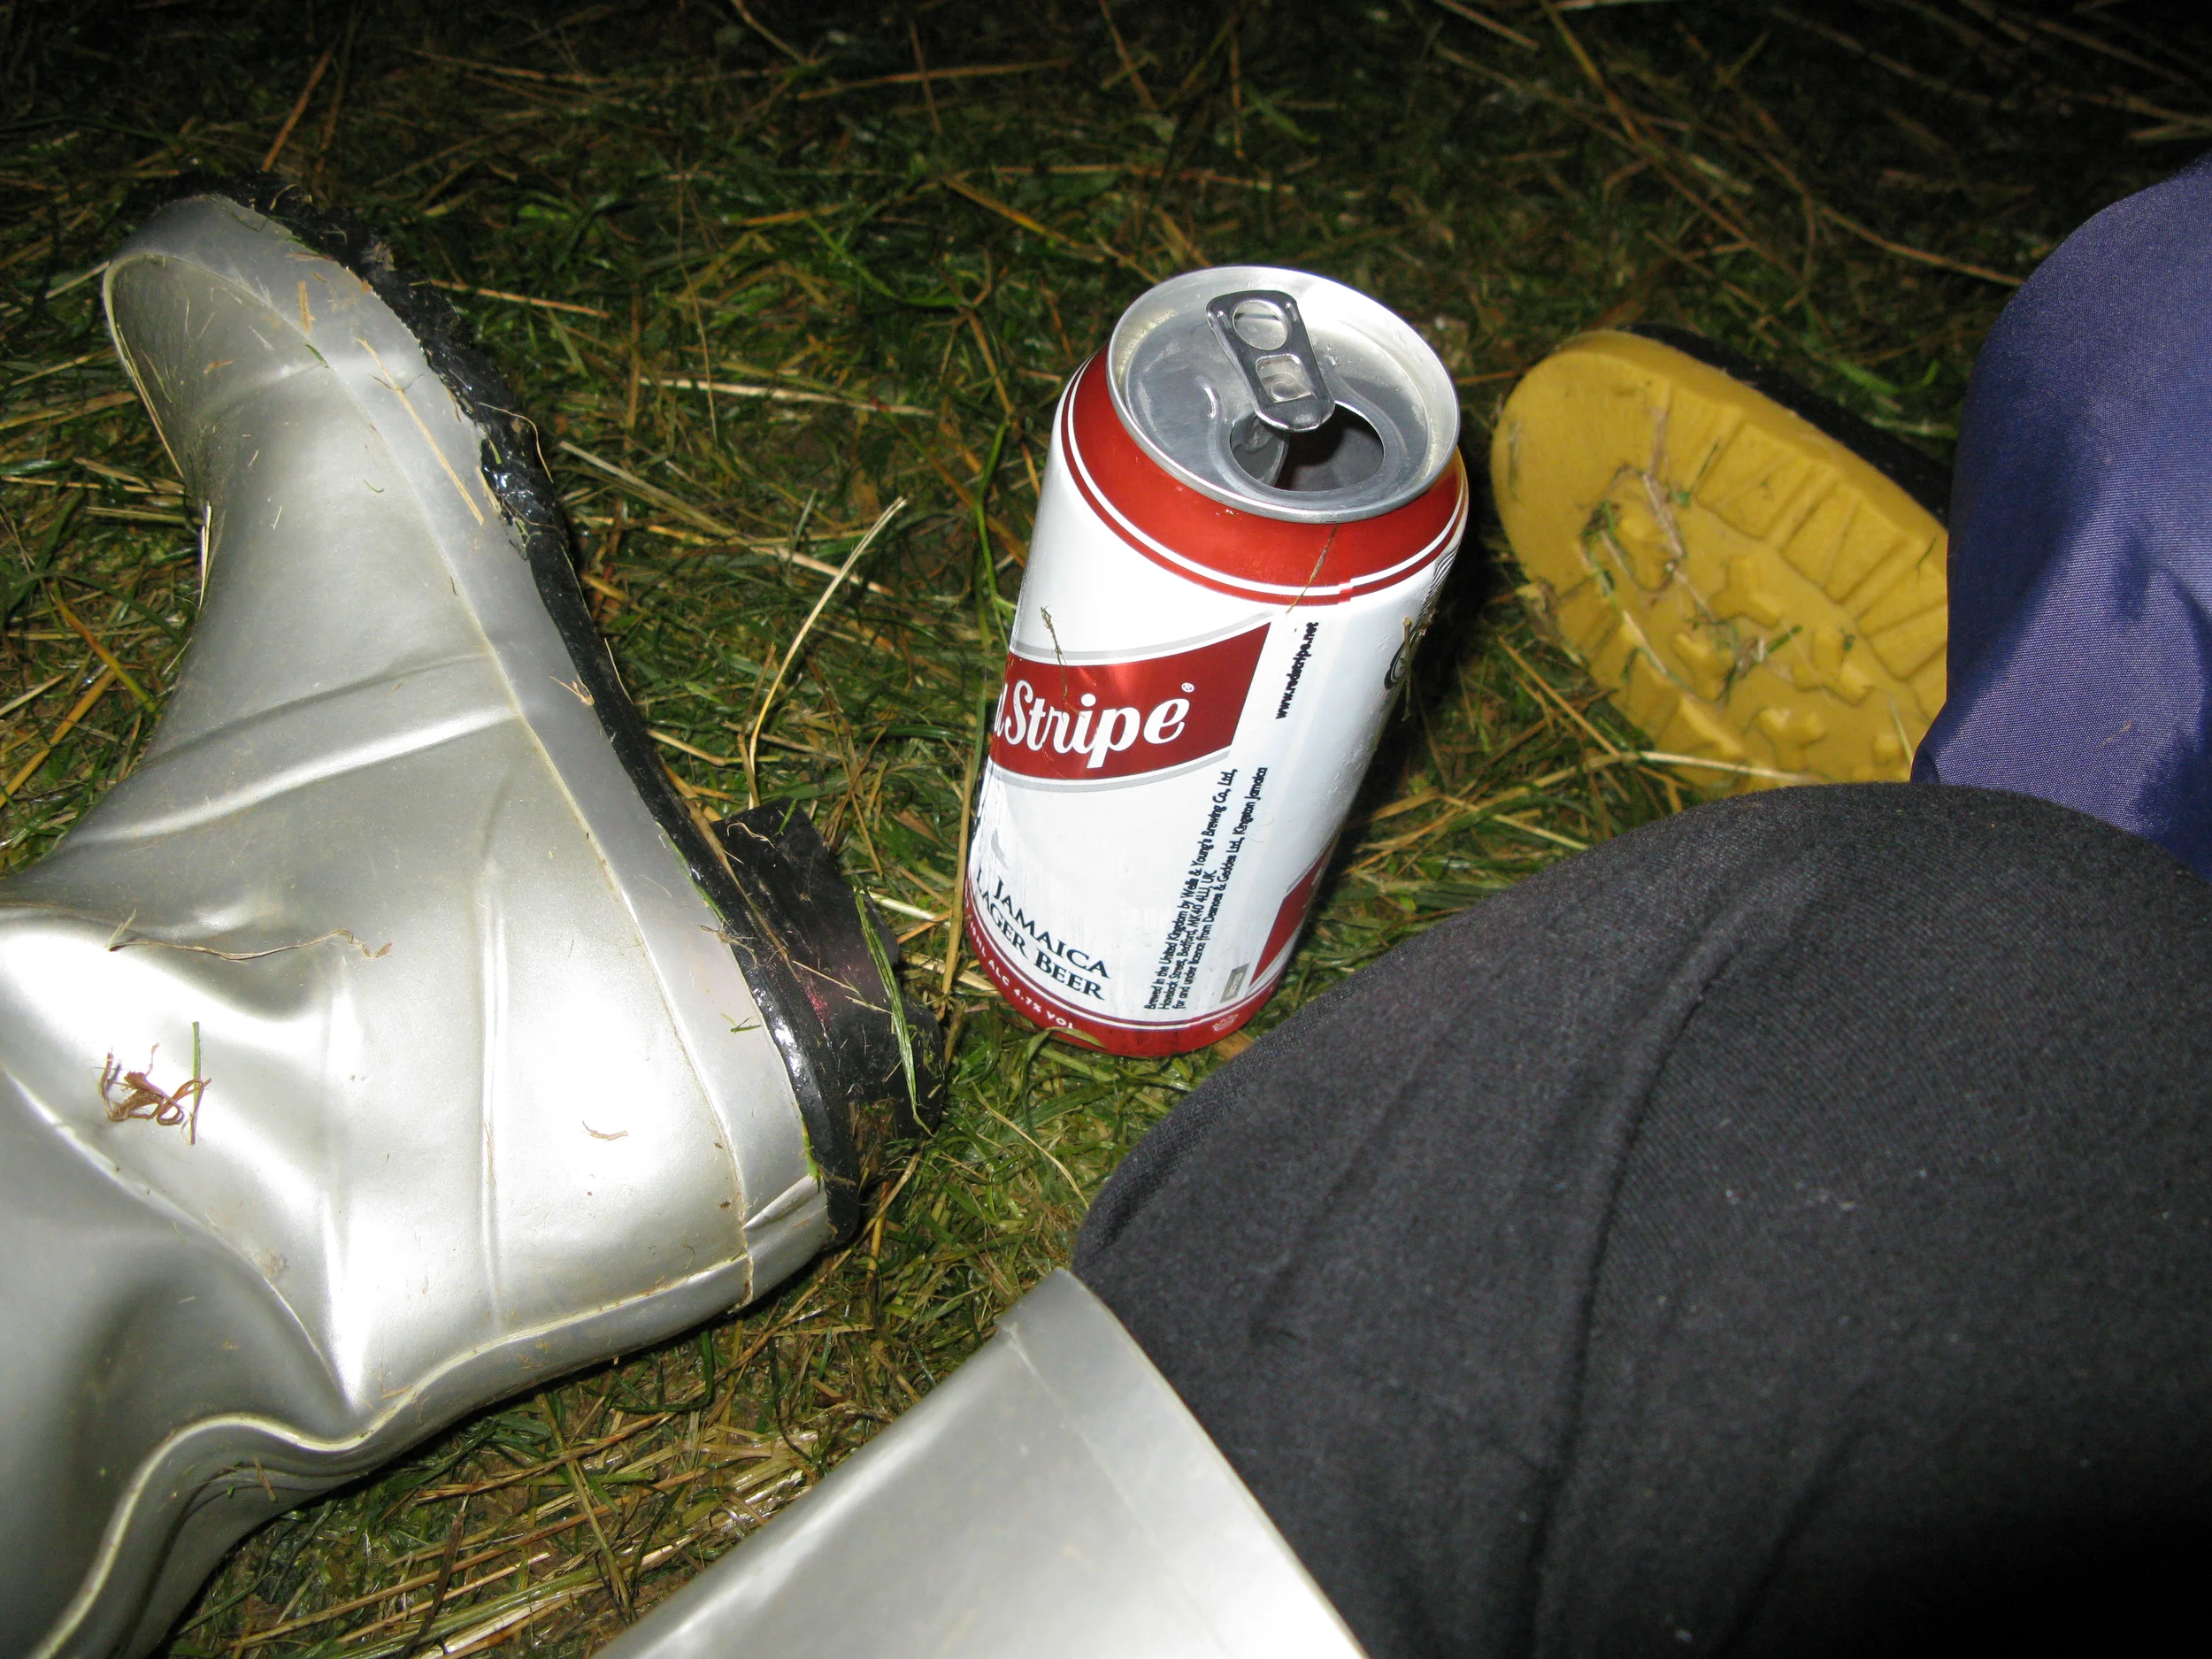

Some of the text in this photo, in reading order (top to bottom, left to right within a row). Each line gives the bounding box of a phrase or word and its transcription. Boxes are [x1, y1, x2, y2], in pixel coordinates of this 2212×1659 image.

[1275, 622, 1319, 719] www.redstripe.net
[1244, 767, 1268, 801] Jamaica
[1201, 804, 1227, 837] Brewing
[1232, 802, 1256, 834] Kingston
[1190, 838, 1214, 866] Young's
[1188, 867, 1202, 876] &
[1217, 855, 1237, 882] Geddes
[1180, 878, 1199, 898] Wells
[1177, 900, 1195, 909] by
[1187, 903, 1204, 927] MK40
[976, 864, 1028, 959] LAGER
[1033, 947, 1105, 1001] BEER
[992, 875, 1111, 979] JAMAICA
[1166, 910, 1189, 941] Kingdom
[1195, 924, 1213, 941] from
[1158, 941, 1178, 964] United
[1176, 929, 1199, 956] Bedford,
[1187, 942, 1206, 964] licence
[988, 959, 1010, 986] ALC
[1155, 966, 1170, 977] the
[1168, 958, 1187, 979] Street,
[1184, 966, 1197, 985] under
[1143, 985, 1163, 1010] Brewed
[1157, 980, 1179, 1010] Havelock
[1171, 1000, 1187, 1010] for
[1179, 987, 1190, 999] and
